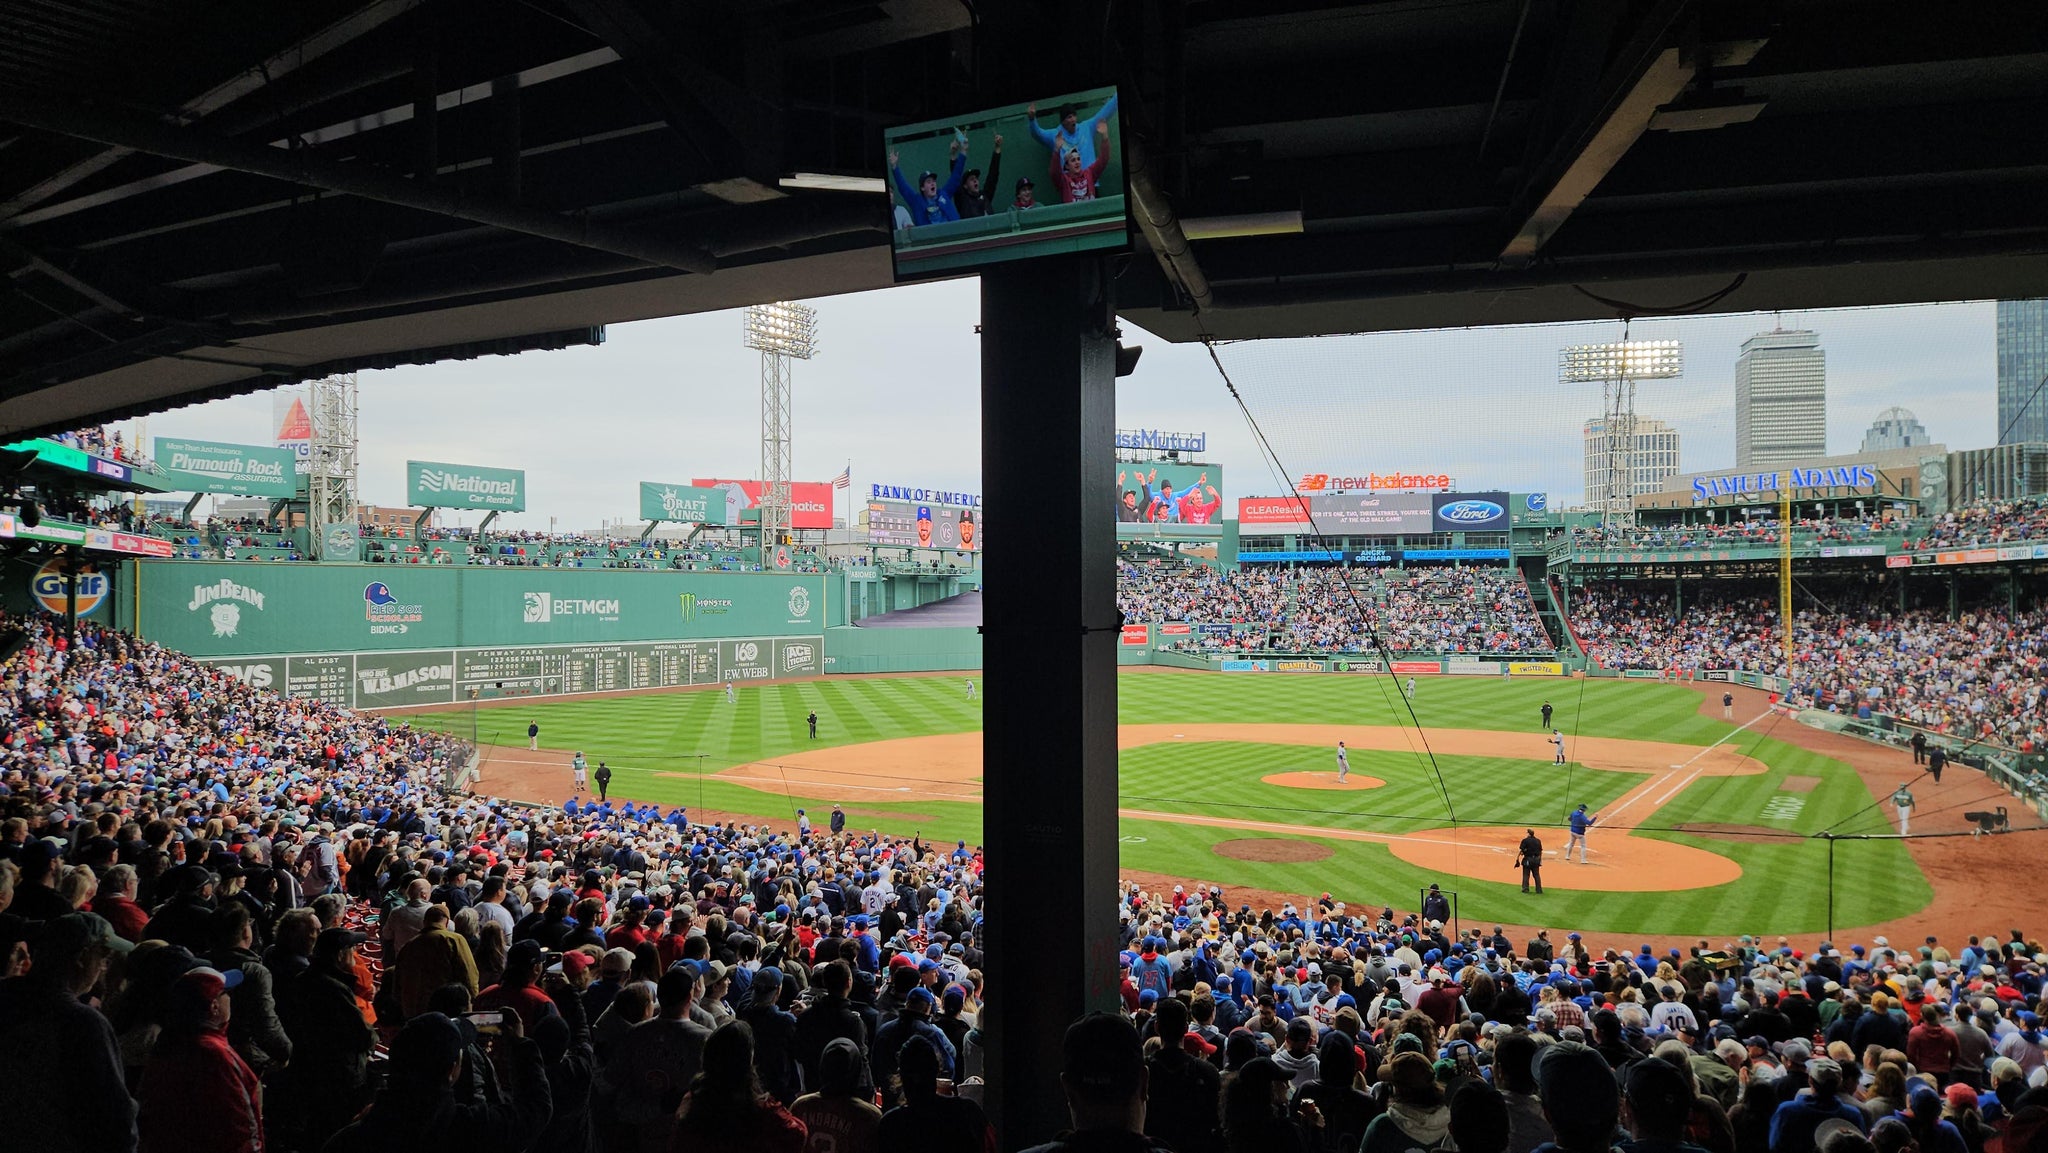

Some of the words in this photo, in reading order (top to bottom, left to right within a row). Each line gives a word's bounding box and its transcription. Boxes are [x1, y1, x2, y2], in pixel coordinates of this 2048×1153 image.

[170, 453, 243, 473] Plymouth
[246, 459, 283, 476] Rock
[1332, 476, 1368, 490] new
[1369, 472, 1450, 490] balance
[1692, 471, 1785, 500] SAMUEL
[1789, 465, 1877, 487] ADAMS
[469, 494, 484, 502] Car
[486, 495, 513, 504] Rental
[872, 483, 911, 500] BANK
[915, 489, 931, 501] OF
[935, 490, 981, 507] AMERIC
[663, 497, 707, 511] DRAFT
[1246, 505, 1303, 515] CLEAResult
[668, 509, 706, 521] KINGS
[1450, 503, 1491, 519] Ford
[942, 528, 951, 539] VS
[850, 571, 876, 579] ABIOMED
[553, 599, 619, 615] BETMGM
[696, 598, 733, 607] MONSTER
[371, 605, 396, 614] RED
[398, 605, 422, 614] SOX
[370, 625, 399, 634] BIDMC
[735, 642, 758, 661] 160
[788, 646, 811, 658] ACE
[789, 656, 811, 666] TICKET
[1350, 662, 1378, 670] wasabi
[742, 667, 768, 678] WEBB
[1519, 665, 1542, 673] TWISTED
[870, 897, 875, 909] 2
[1667, 1016, 1685, 1031] 10
